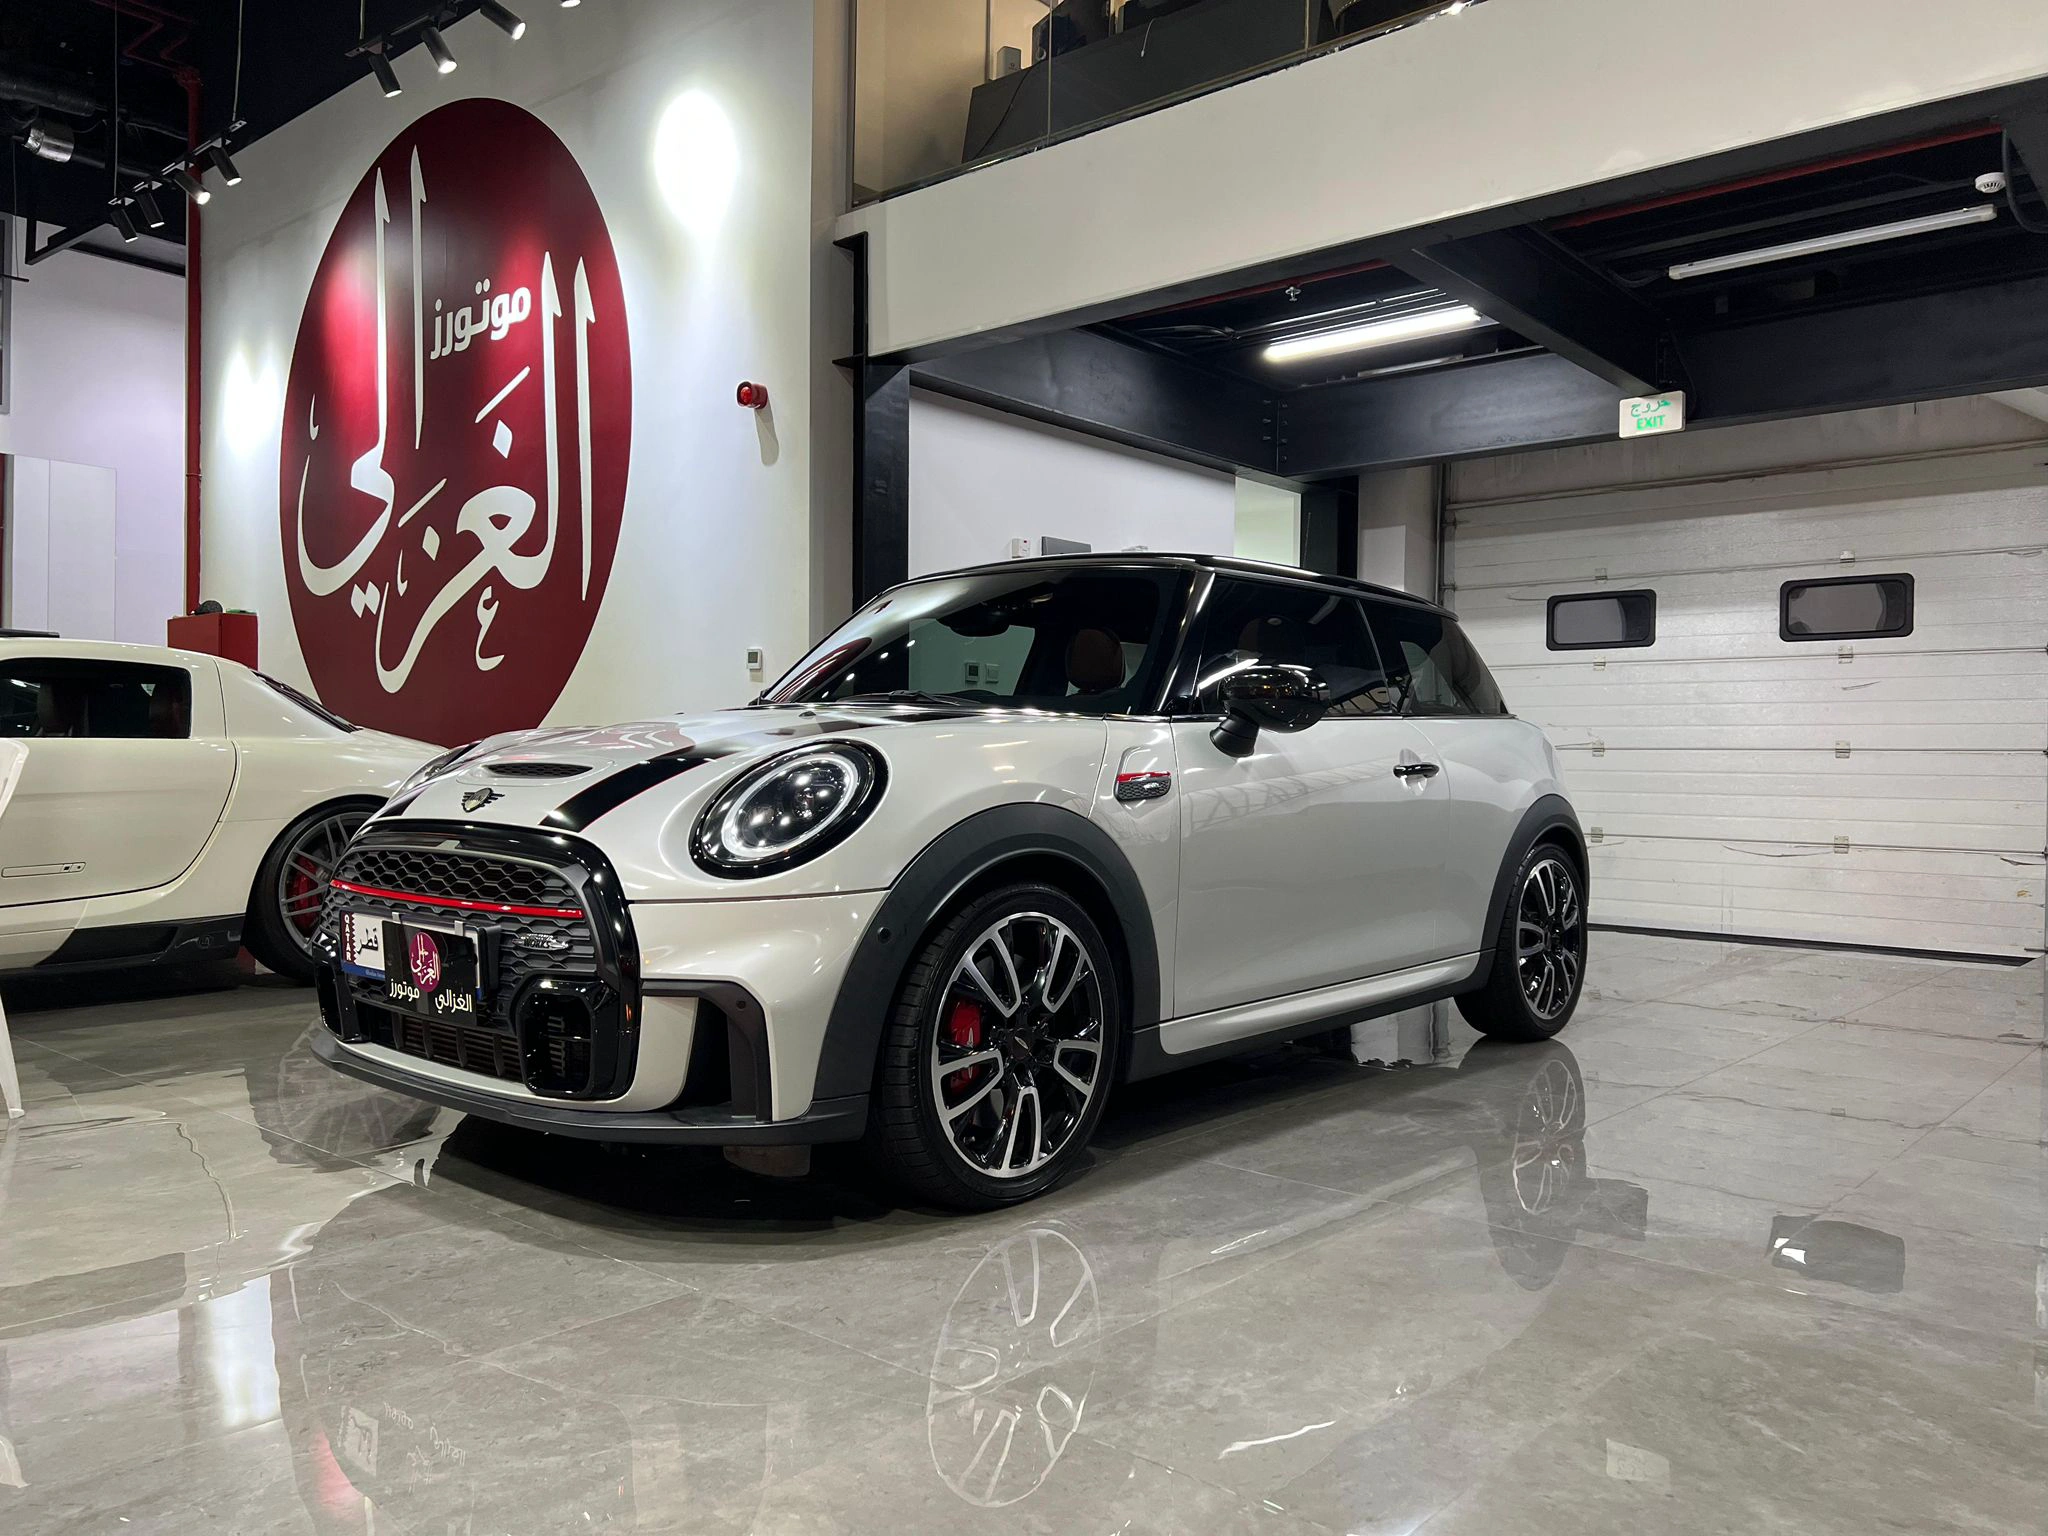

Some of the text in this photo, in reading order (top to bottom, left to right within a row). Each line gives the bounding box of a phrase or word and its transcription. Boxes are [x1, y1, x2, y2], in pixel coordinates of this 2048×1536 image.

[430, 282, 532, 361] موتورز
[1637, 415, 1665, 430] EXIT
[344, 914, 352, 961] QATAR
[356, 927, 379, 955] قطر
[389, 979, 473, 1014] الغزالي موتورز
